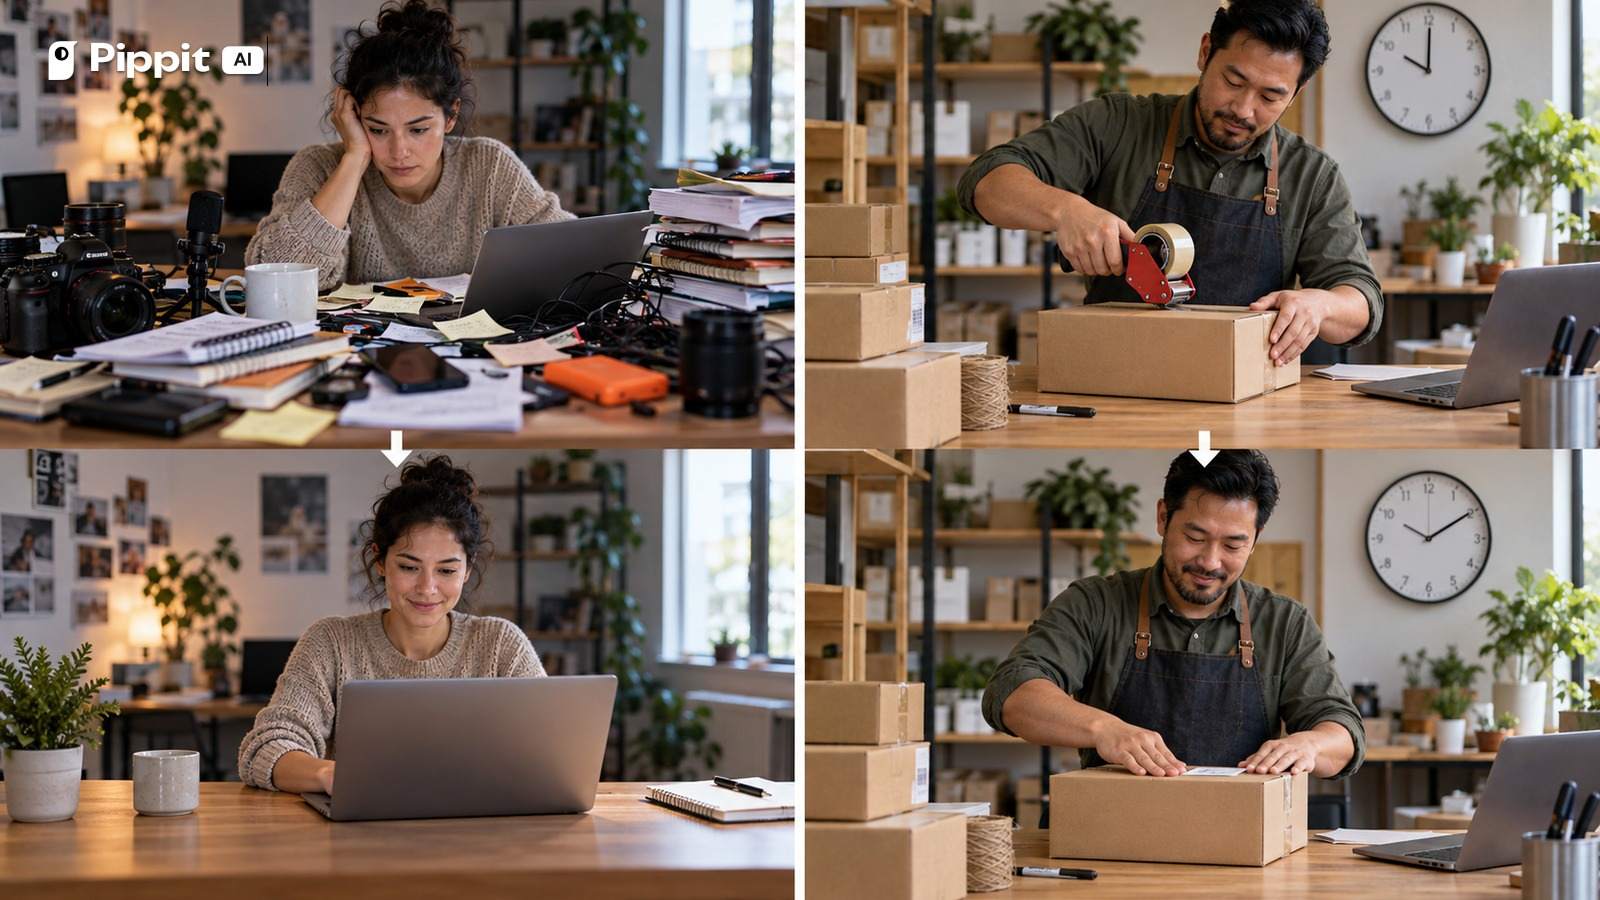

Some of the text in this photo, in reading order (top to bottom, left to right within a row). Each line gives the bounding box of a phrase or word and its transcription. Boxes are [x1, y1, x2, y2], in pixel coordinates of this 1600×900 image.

[1424, 14, 1434, 26] 12
[1401, 22, 1410, 33] 11
[1384, 40, 1394, 51] 10
[1467, 40, 1474, 51] 2
[1376, 65, 1384, 76] 9
[1474, 65, 1480, 76] 3
[1384, 89, 1391, 101] 8
[1466, 90, 1473, 101] 4
[1402, 107, 1409, 118] 7
[1449, 107, 1456, 118] 5
[1425, 114, 1432, 125] 6
[1423, 483, 1434, 494] 12
[1401, 490, 1410, 501] 11
[1383, 508, 1394, 520] 10
[1376, 533, 1383, 544] 9
[1474, 533, 1481, 544] 3
[1384, 558, 1391, 569] 8
[1466, 558, 1473, 568] 4
[1402, 575, 1409, 586] 7
[1450, 575, 1456, 586] 5
[1425, 582, 1432, 593] 6
